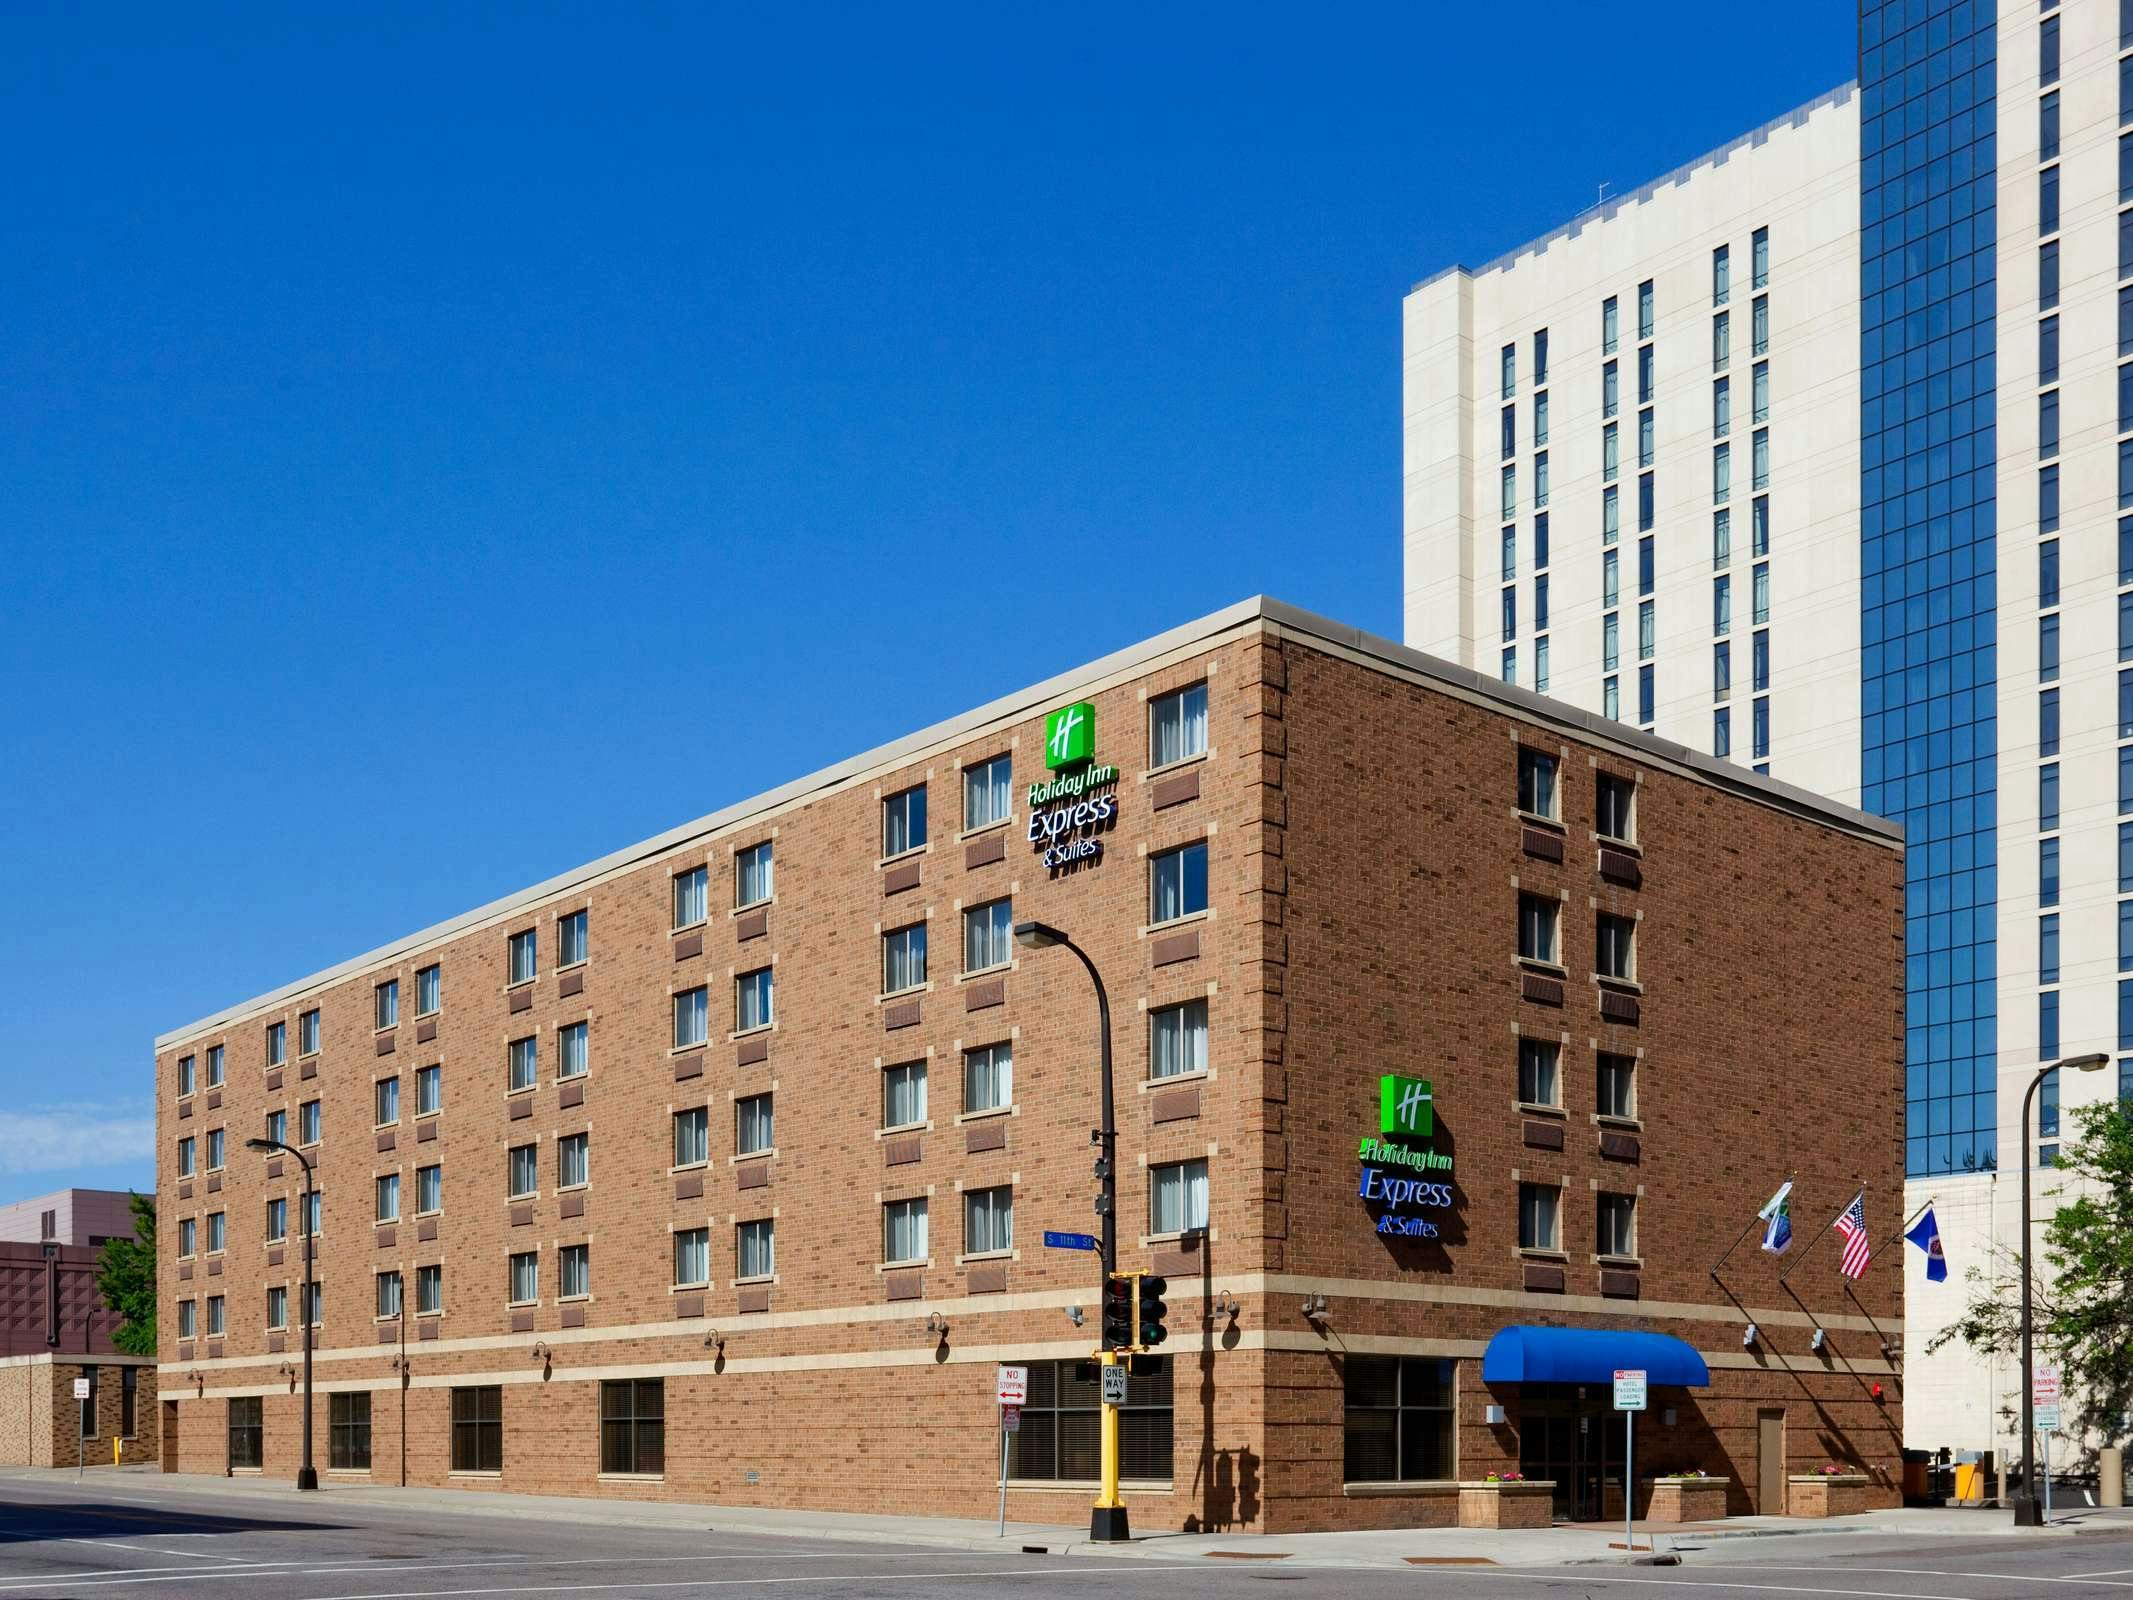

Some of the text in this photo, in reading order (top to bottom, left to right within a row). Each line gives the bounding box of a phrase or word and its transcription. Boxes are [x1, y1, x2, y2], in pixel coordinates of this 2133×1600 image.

[1027, 763, 1112, 807] Holiday Inn
[1027, 794, 1112, 843] Express
[1042, 838, 1098, 868] & Suites
[1365, 1138, 1453, 1173] Holiday Inn
[1365, 1168, 1453, 1210] Express
[1383, 1215, 1439, 1239] & Suites
[1047, 1234, 1092, 1247] S 11th St
[1006, 1370, 1019, 1379] NO
[1105, 1368, 1124, 1378] ONE
[2040, 1369, 2051, 1377] NO
[999, 1382, 1025, 1390] STOPPING
[1105, 1379, 1124, 1389] WAY
